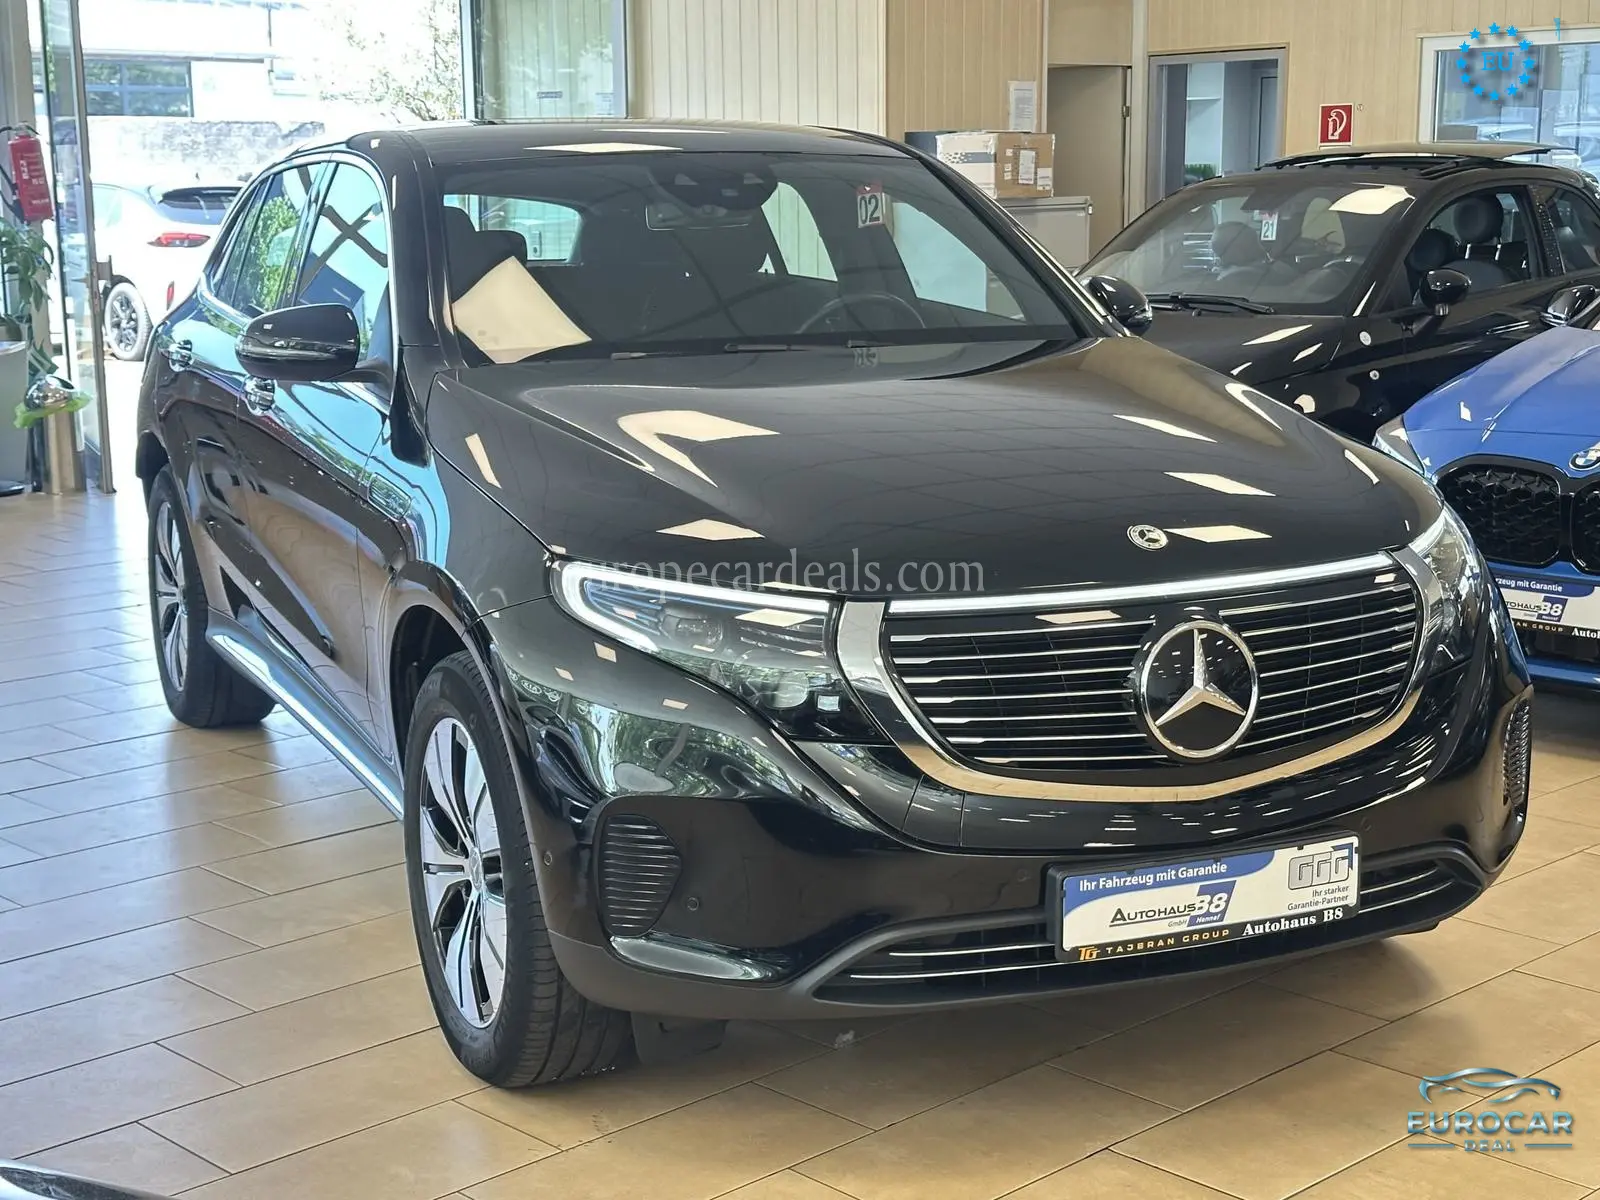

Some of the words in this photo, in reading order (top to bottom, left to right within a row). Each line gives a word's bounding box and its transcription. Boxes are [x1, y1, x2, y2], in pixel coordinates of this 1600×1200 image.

[859, 195, 880, 224] 02
[1263, 221, 1275, 238] 21
[1516, 579, 1529, 588] mit
[1530, 581, 1563, 592] Garantie
[1079, 880, 1099, 891] Ihr
[1099, 874, 1153, 889] Fahrzeug
[1156, 870, 1175, 881] mit
[1178, 862, 1228, 878] Garantie
[1312, 887, 1323, 898] Ihr
[1323, 885, 1349, 896] starker
[1287, 894, 1349, 911] Garantie-Partner
[1242, 915, 1316, 936] Autohaus
[1322, 907, 1344, 922] B8
[1182, 930, 1229, 942] GROUP
